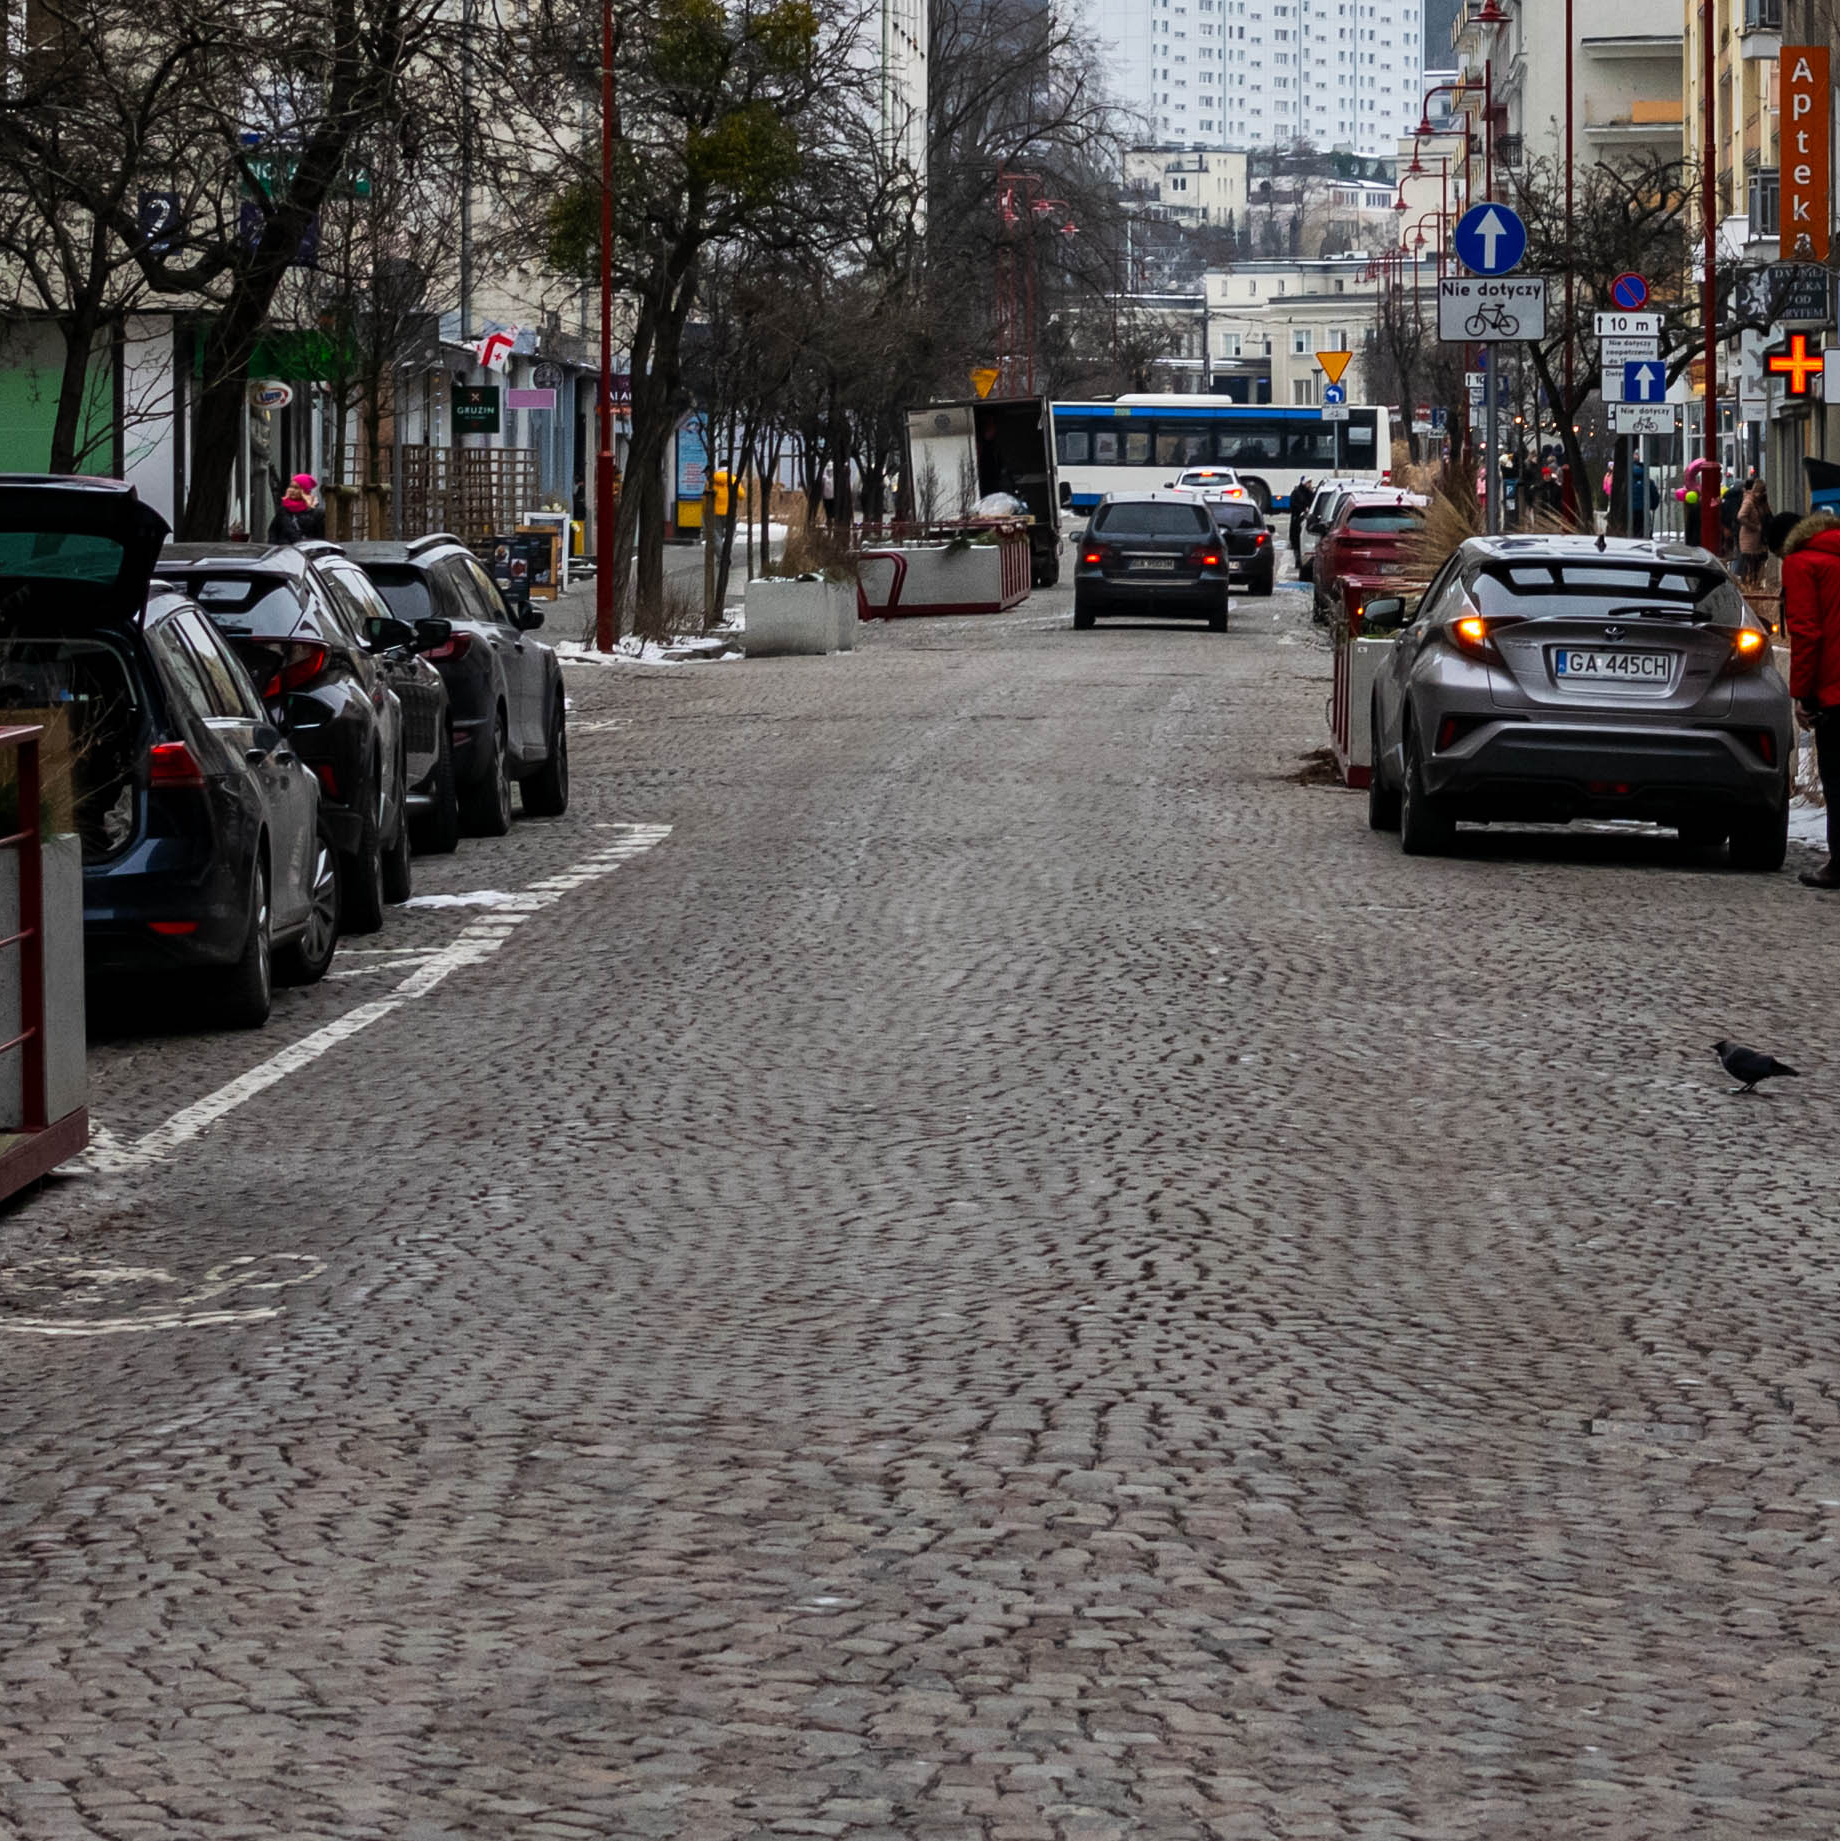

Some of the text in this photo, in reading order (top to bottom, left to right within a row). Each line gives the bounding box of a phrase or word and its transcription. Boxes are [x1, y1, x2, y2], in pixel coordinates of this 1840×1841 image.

[1790, 55, 1815, 252] Apteka
[1441, 282, 1542, 300] Nie dotyczy
[1610, 317, 1649, 332] 10 m
[1623, 339, 1652, 348] dotyczy
[1620, 407, 1671, 417] Nie dotyczy
[1568, 652, 1667, 676] GA 445CH
